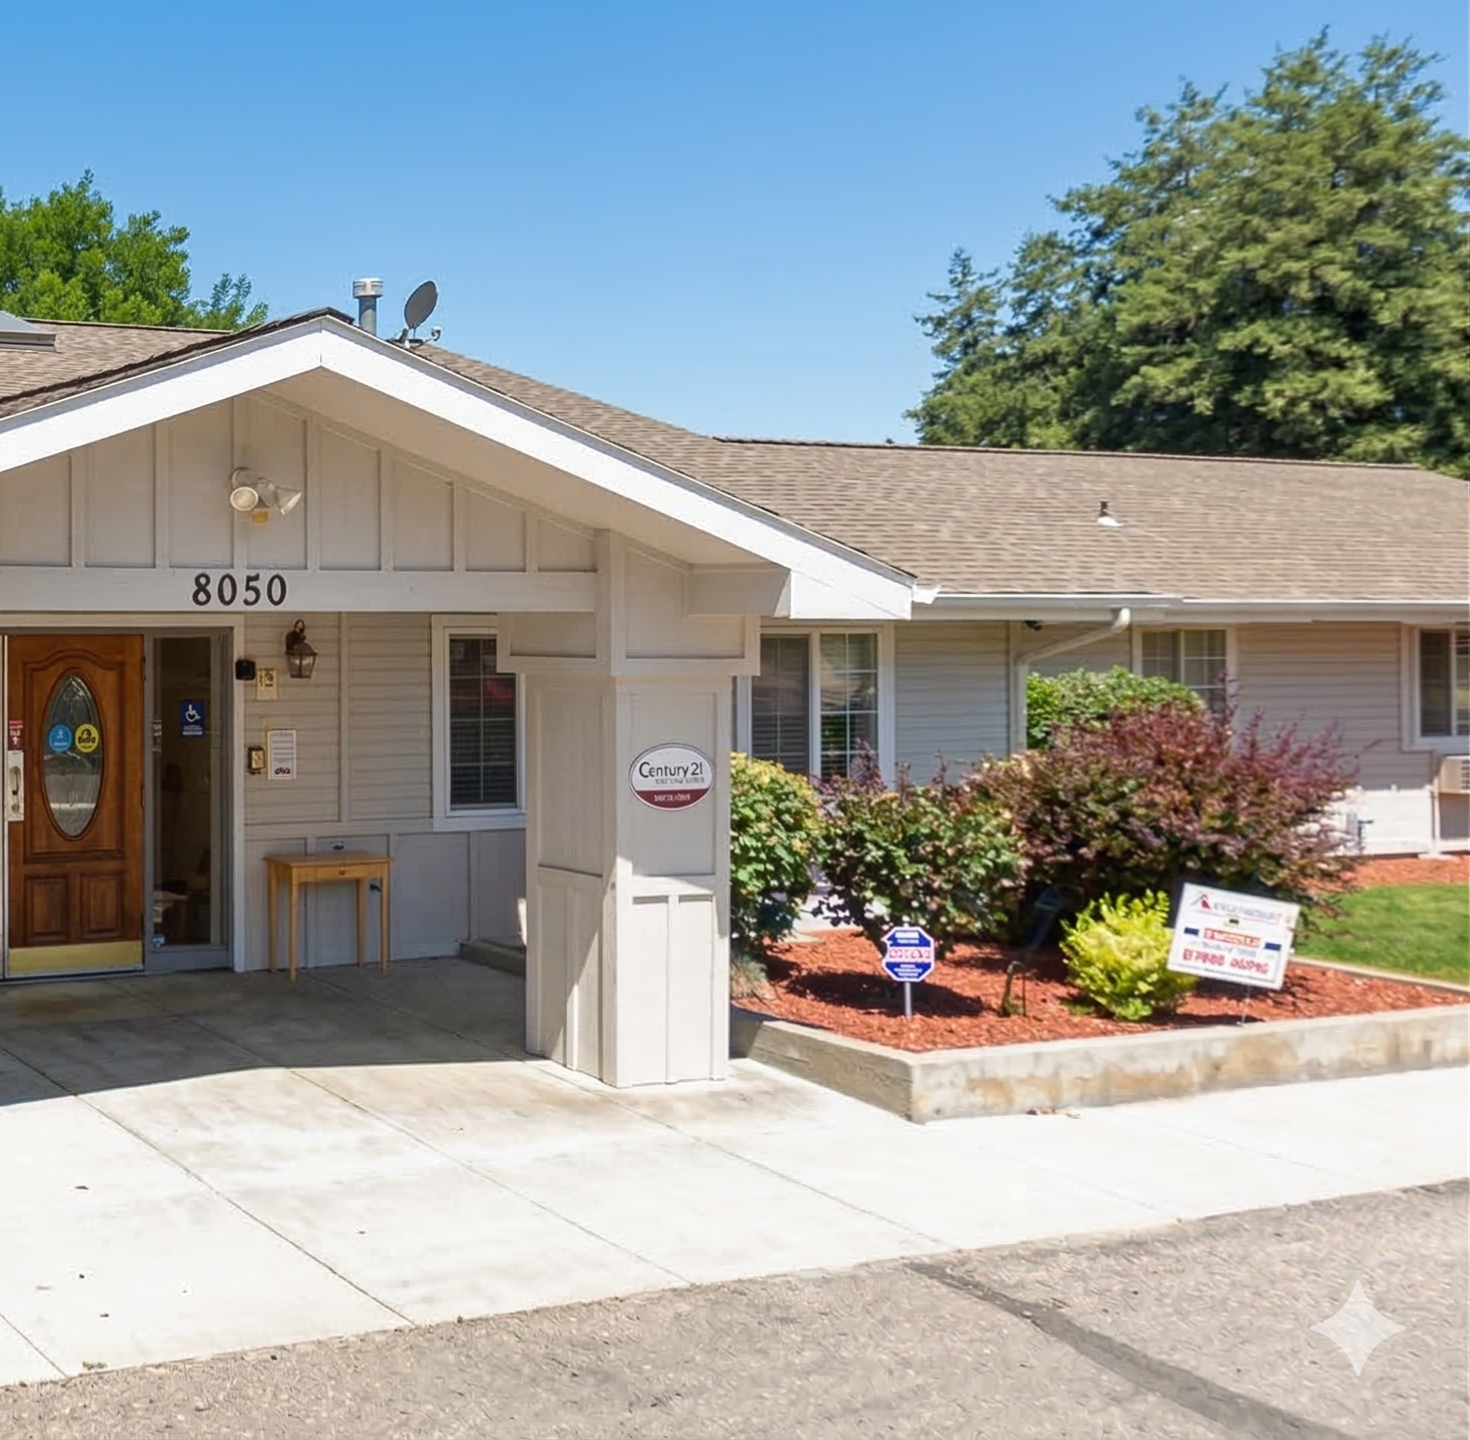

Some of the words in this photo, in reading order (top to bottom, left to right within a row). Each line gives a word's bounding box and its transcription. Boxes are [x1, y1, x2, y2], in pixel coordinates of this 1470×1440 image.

[192, 572, 287, 606] 8050
[638, 761, 689, 778] Century
[691, 761, 704, 776] 21
